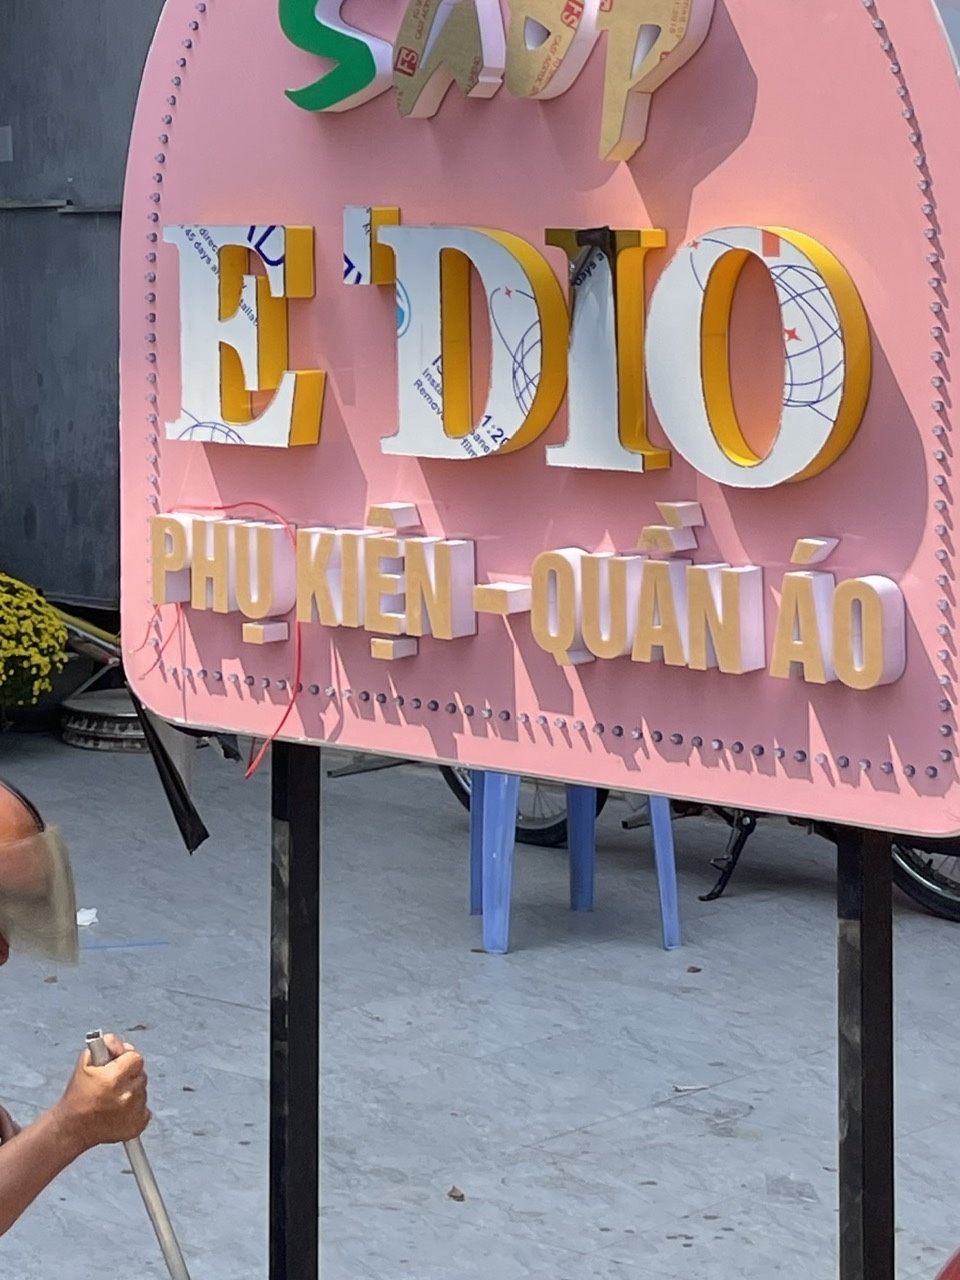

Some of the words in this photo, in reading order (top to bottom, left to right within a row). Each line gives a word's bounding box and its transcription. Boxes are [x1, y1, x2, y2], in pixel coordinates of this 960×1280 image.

[198, 227, 220, 256] direc
[163, 206, 873, 489] E'DIO
[413, 378, 444, 420] Remov
[151, 513, 297, 645] PHỤ
[296, 502, 478, 660] KIỆN
[530, 500, 766, 675] QUẦN
[769, 536, 906, 691] ÁO
